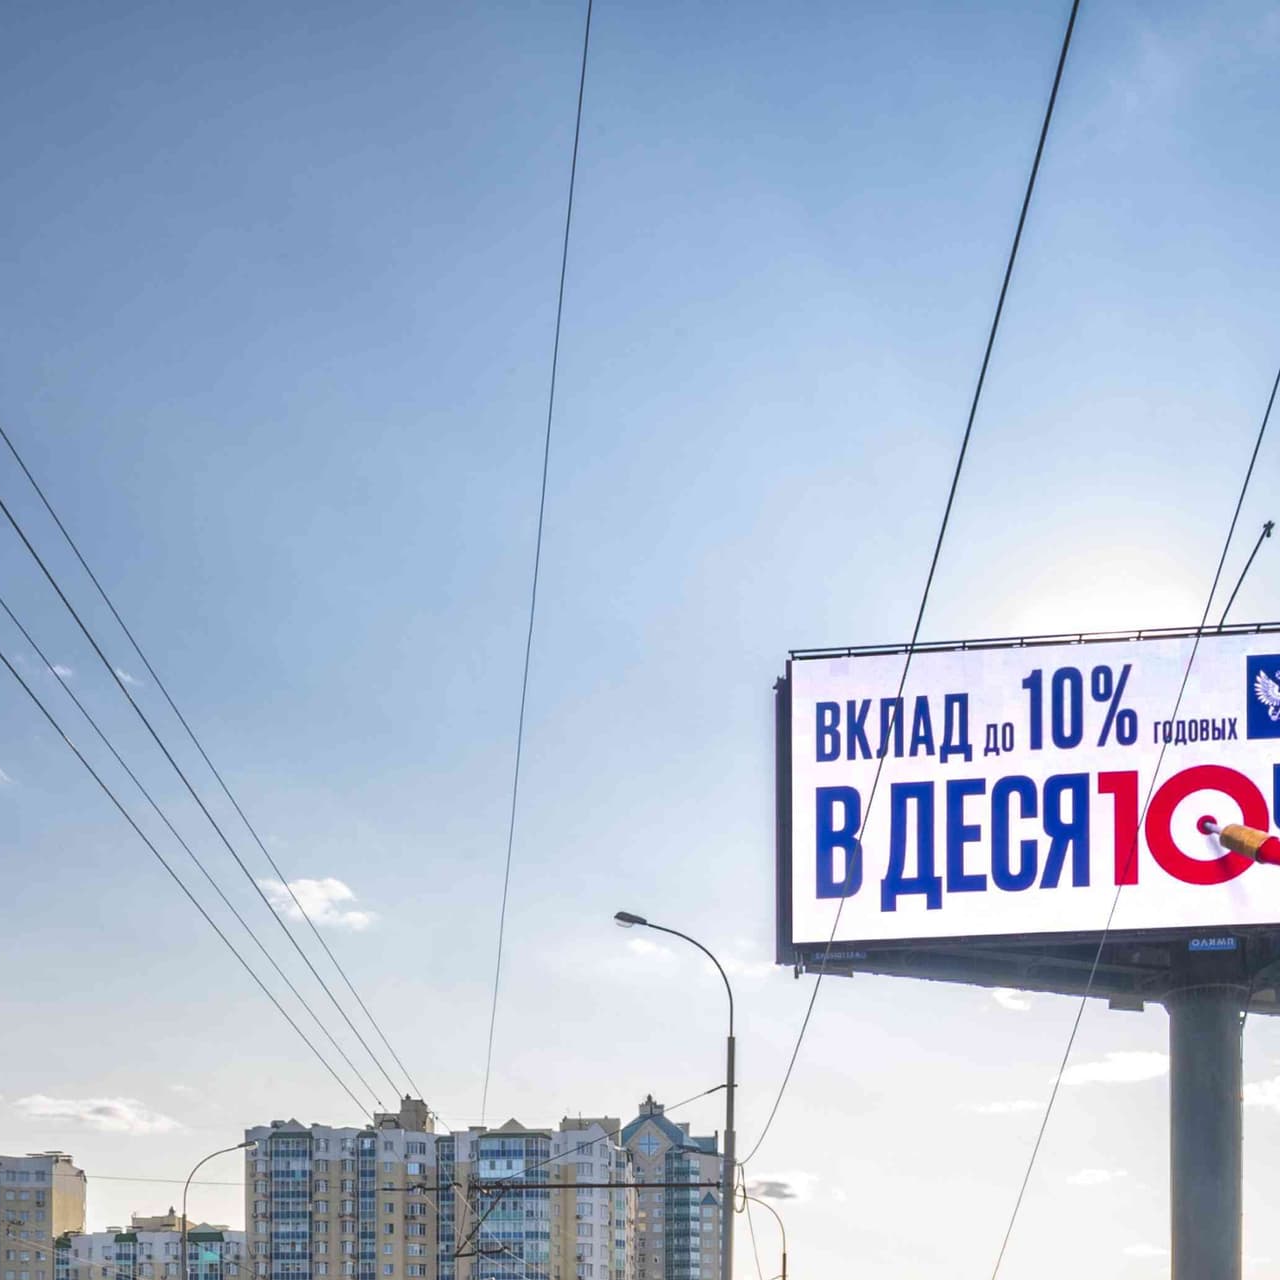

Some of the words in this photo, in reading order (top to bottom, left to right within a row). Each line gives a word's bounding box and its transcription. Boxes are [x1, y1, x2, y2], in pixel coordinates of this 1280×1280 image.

[815, 692, 973, 764] ВКЛАД
[1021, 663, 1138, 751] 10%
[815, 785, 863, 900] В
[1191, 937, 1234, 947] ОЛИМП
